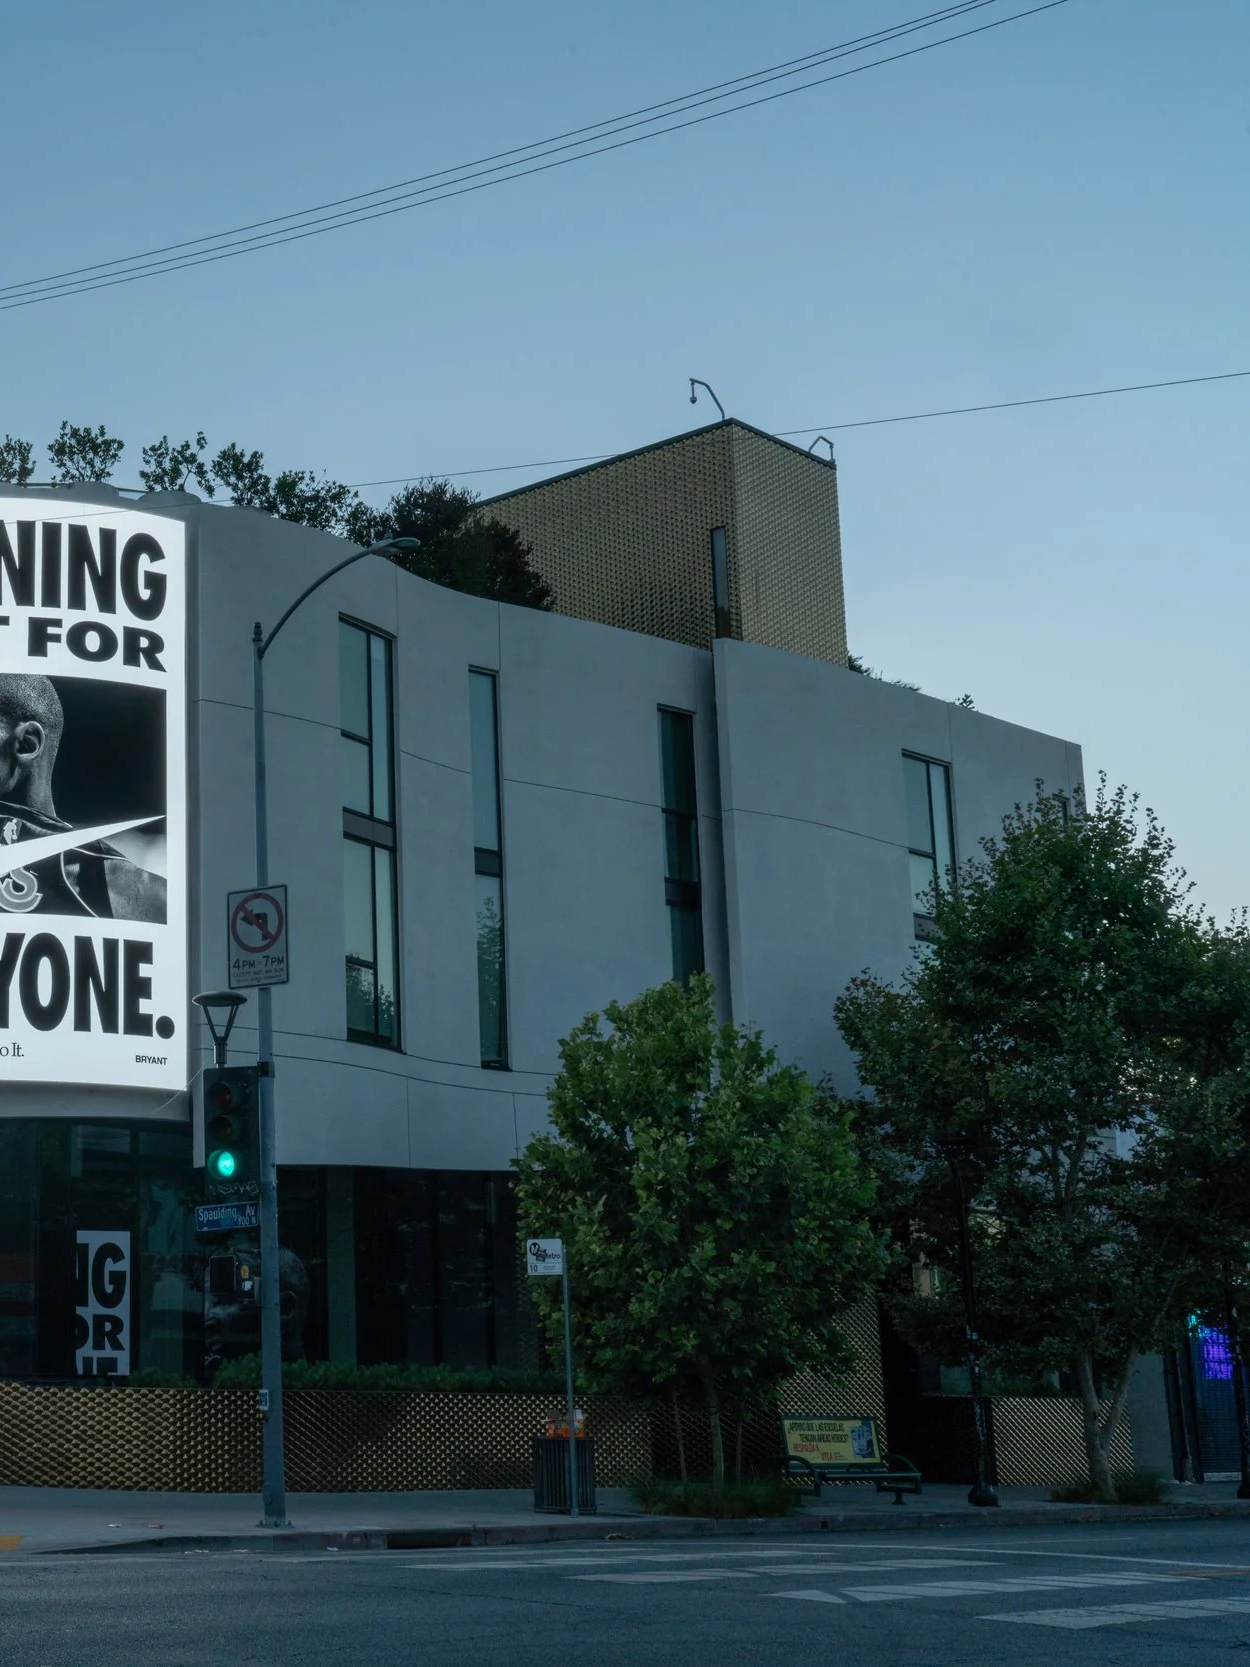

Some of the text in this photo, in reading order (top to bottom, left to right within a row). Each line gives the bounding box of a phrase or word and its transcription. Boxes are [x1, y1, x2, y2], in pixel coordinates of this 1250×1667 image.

[28, 616, 167, 673] FOR
[12, 1042, 24, 1057] It.
[135, 1055, 168, 1065] BRYANT
[198, 1204, 256, 1223] Spaulding Av
[530, 1264, 538, 1272] 10
